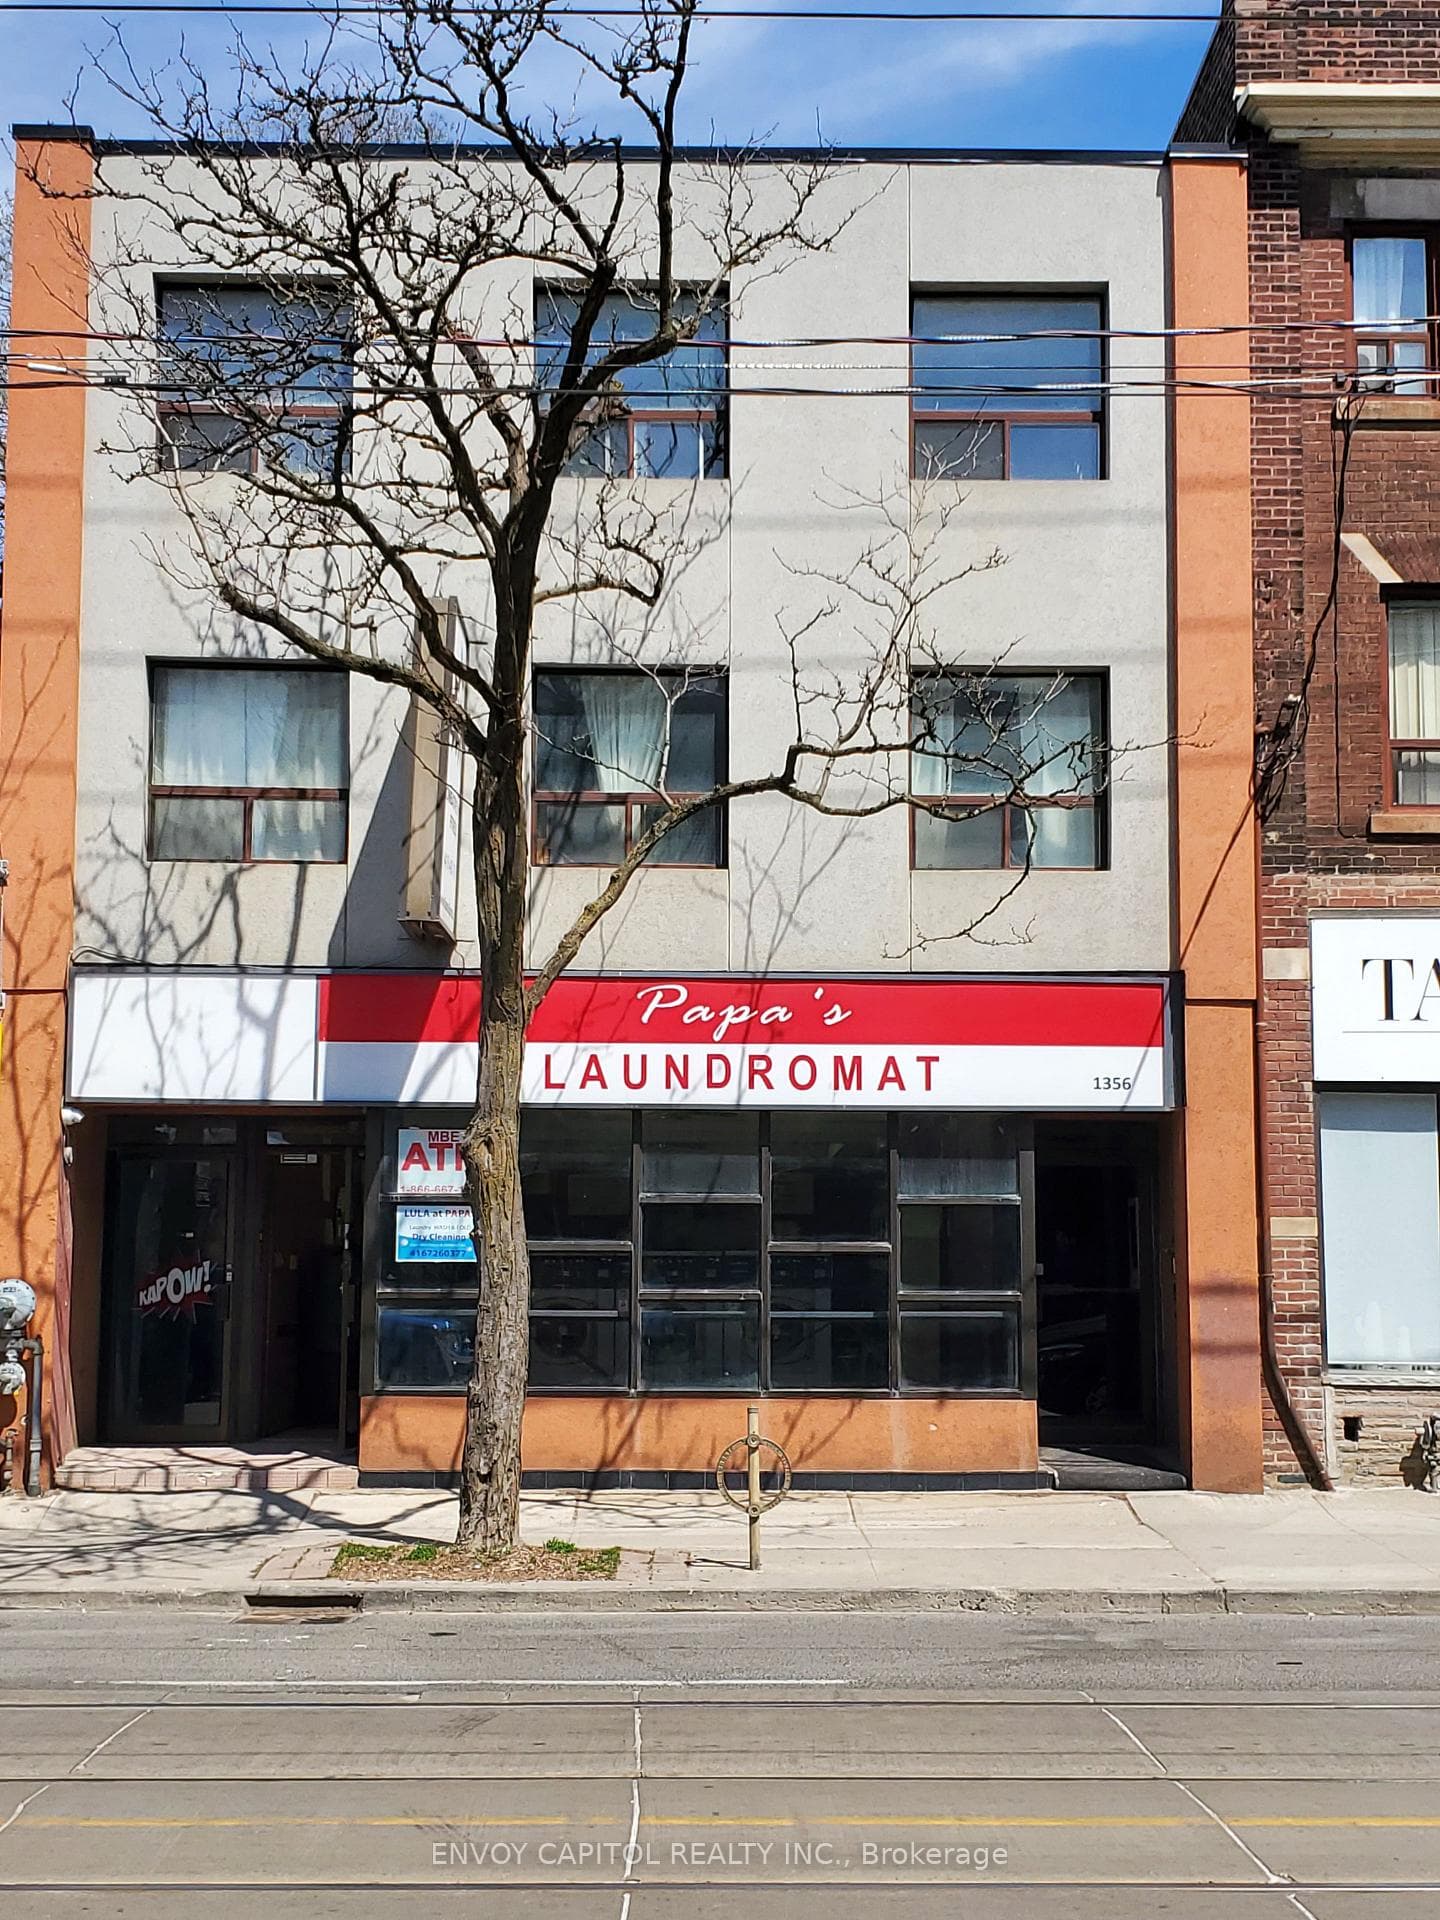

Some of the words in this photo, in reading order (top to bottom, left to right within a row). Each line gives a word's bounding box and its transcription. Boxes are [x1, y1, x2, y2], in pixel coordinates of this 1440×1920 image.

[636, 984, 853, 1042] Papa's
[544, 1053, 940, 1091] LAUNDROMAT
[1093, 1076, 1132, 1090] 1356
[428, 1131, 460, 1142] MBE
[404, 1209, 430, 1218] LULA
[432, 1210, 442, 1218] at
[412, 1233, 428, 1241] Dry
[430, 1232, 467, 1242] Cleaning
